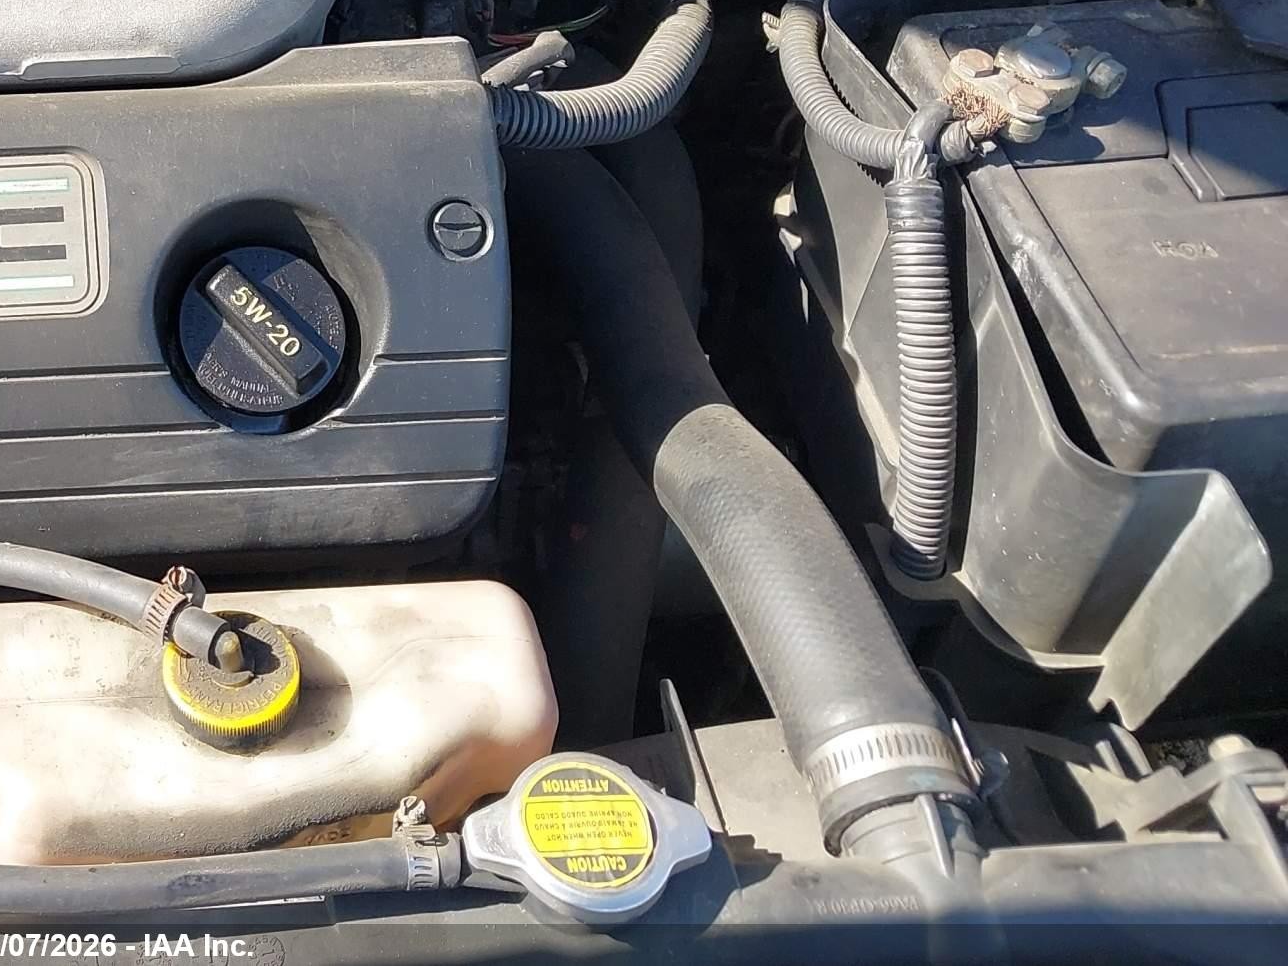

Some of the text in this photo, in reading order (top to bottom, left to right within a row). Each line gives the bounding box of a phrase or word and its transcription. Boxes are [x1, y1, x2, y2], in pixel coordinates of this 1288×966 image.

[230, 286, 301, 357] 5W-20
[543, 779, 609, 793] ATTENTION
[564, 833, 585, 841] WHEN
[566, 856, 627, 873] CAUTION
